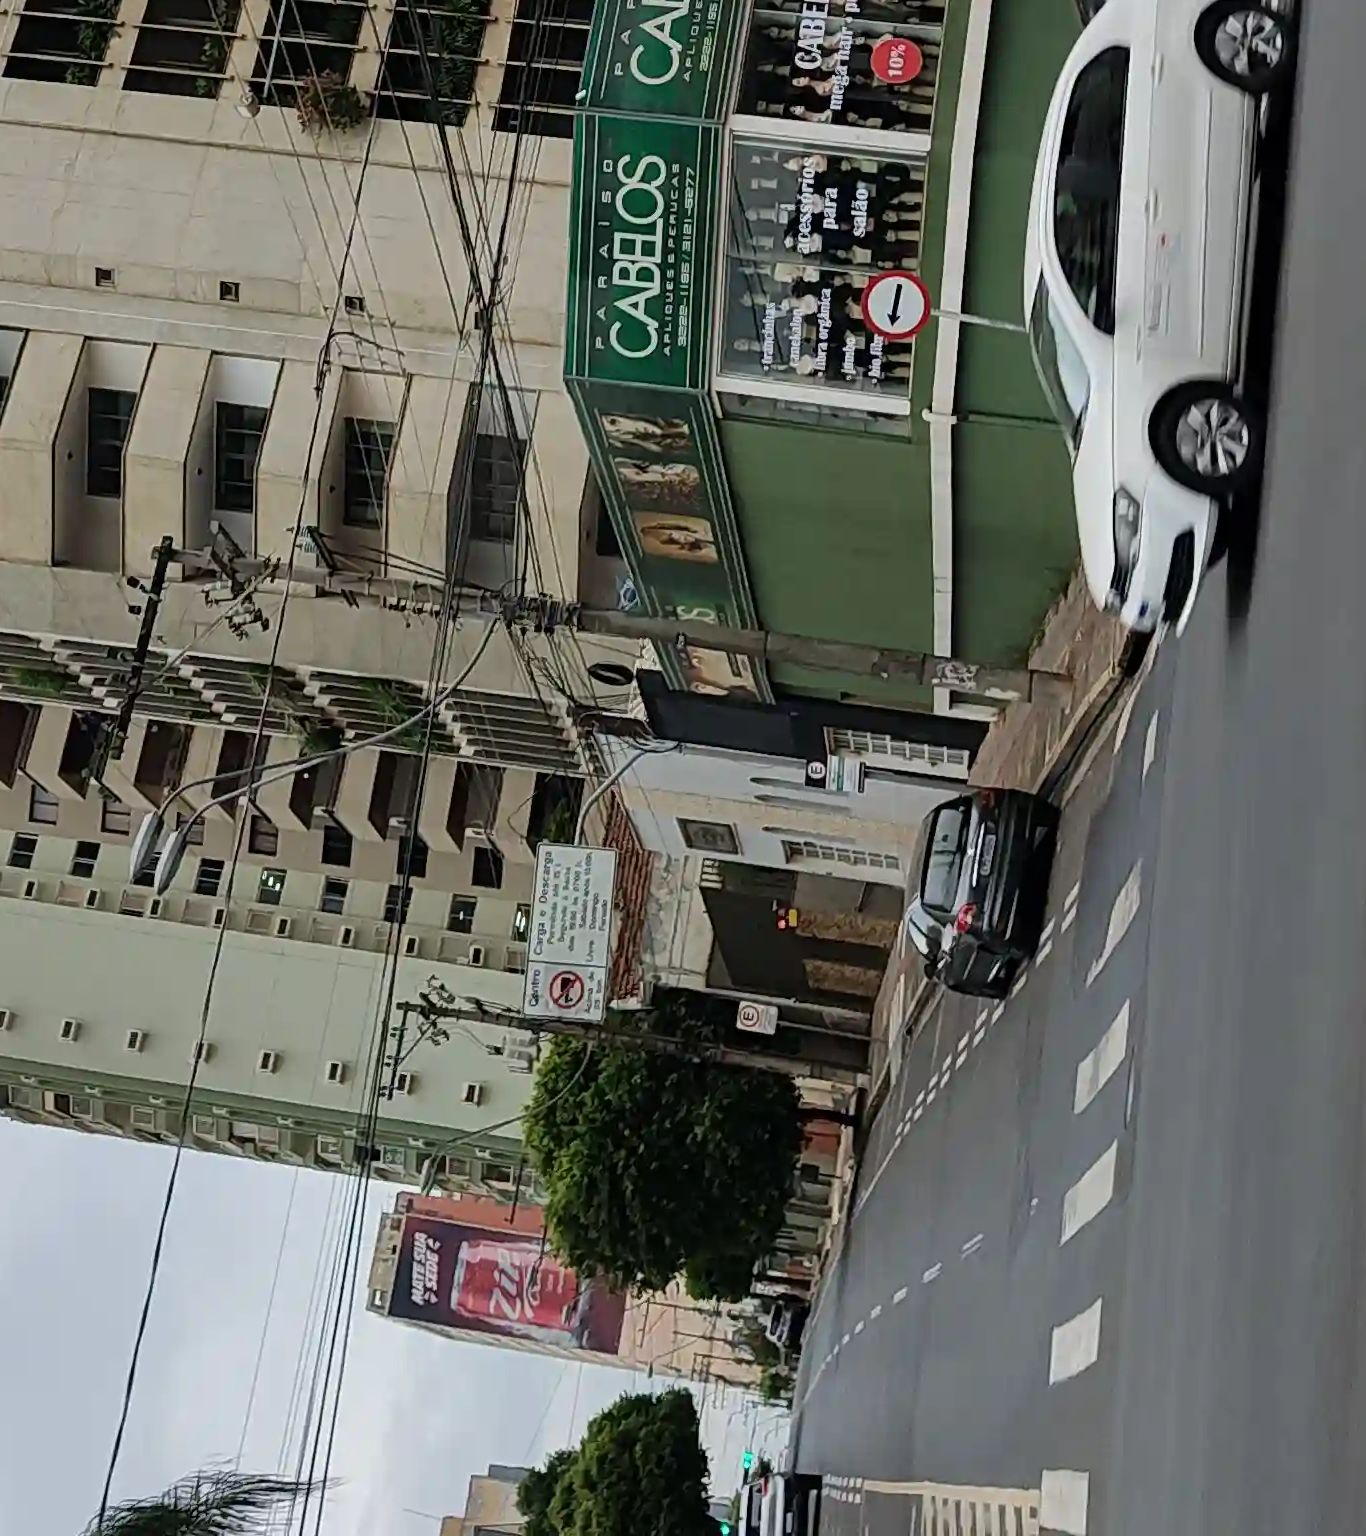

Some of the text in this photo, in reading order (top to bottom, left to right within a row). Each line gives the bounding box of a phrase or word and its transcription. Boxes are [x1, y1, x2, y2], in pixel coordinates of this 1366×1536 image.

[833, 26, 853, 60] hair
[887, 44, 907, 78] 10%
[827, 65, 850, 110] mega
[795, 156, 816, 254] acessórios
[822, 187, 839, 230] para
[851, 189, 869, 238] salão
[609, 154, 667, 358] CABELOS
[663, 163, 680, 356] APLIQUES & PERUCAS
[817, 288, 832, 340] orgânica
[867, 358, 882, 377] bio
[538, 851, 553, 904] Descarga
[533, 922, 547, 955] Carga
[528, 969, 541, 1007] Centro
[410, 1232, 428, 1305] MATE SUA
[424, 1249, 439, 1291] SEDE
